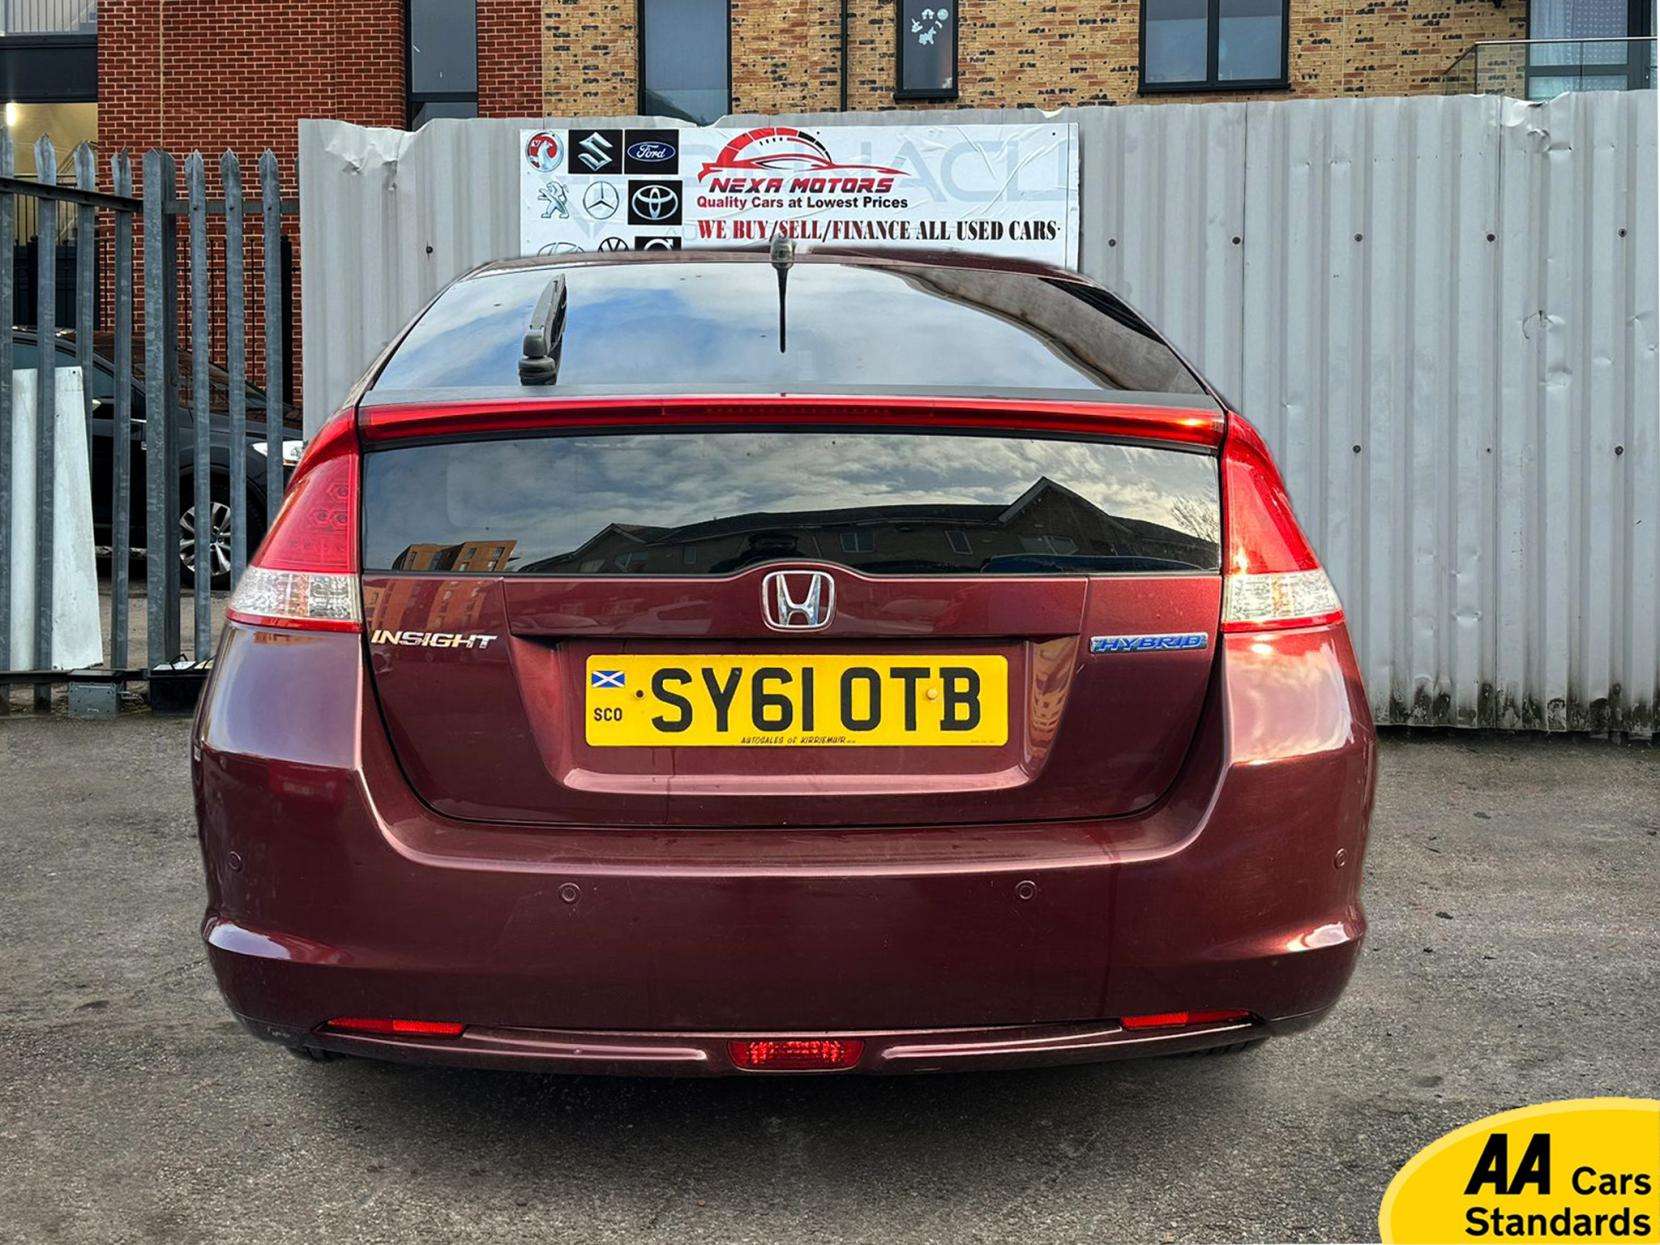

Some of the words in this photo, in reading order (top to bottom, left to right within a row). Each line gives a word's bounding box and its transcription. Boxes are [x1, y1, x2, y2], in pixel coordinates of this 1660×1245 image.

[636, 144, 667, 158] Ford
[709, 178, 784, 194] NEXA
[789, 178, 895, 194] MOTORS
[697, 195, 747, 210] Quality
[751, 196, 784, 209] Cars
[788, 197, 803, 209] at
[807, 196, 859, 209] Lowest
[863, 195, 909, 209] Prices
[697, 219, 727, 239] WE
[916, 219, 951, 240] ALL
[956, 219, 1004, 240] USED
[1008, 219, 1057, 240] CARS
[371, 629, 498, 649] INSIGHT
[1095, 635, 1204, 652] HYBRID
[650, 667, 814, 733] SY61
[840, 666, 982, 732] OTB
[593, 707, 623, 722] SCO
